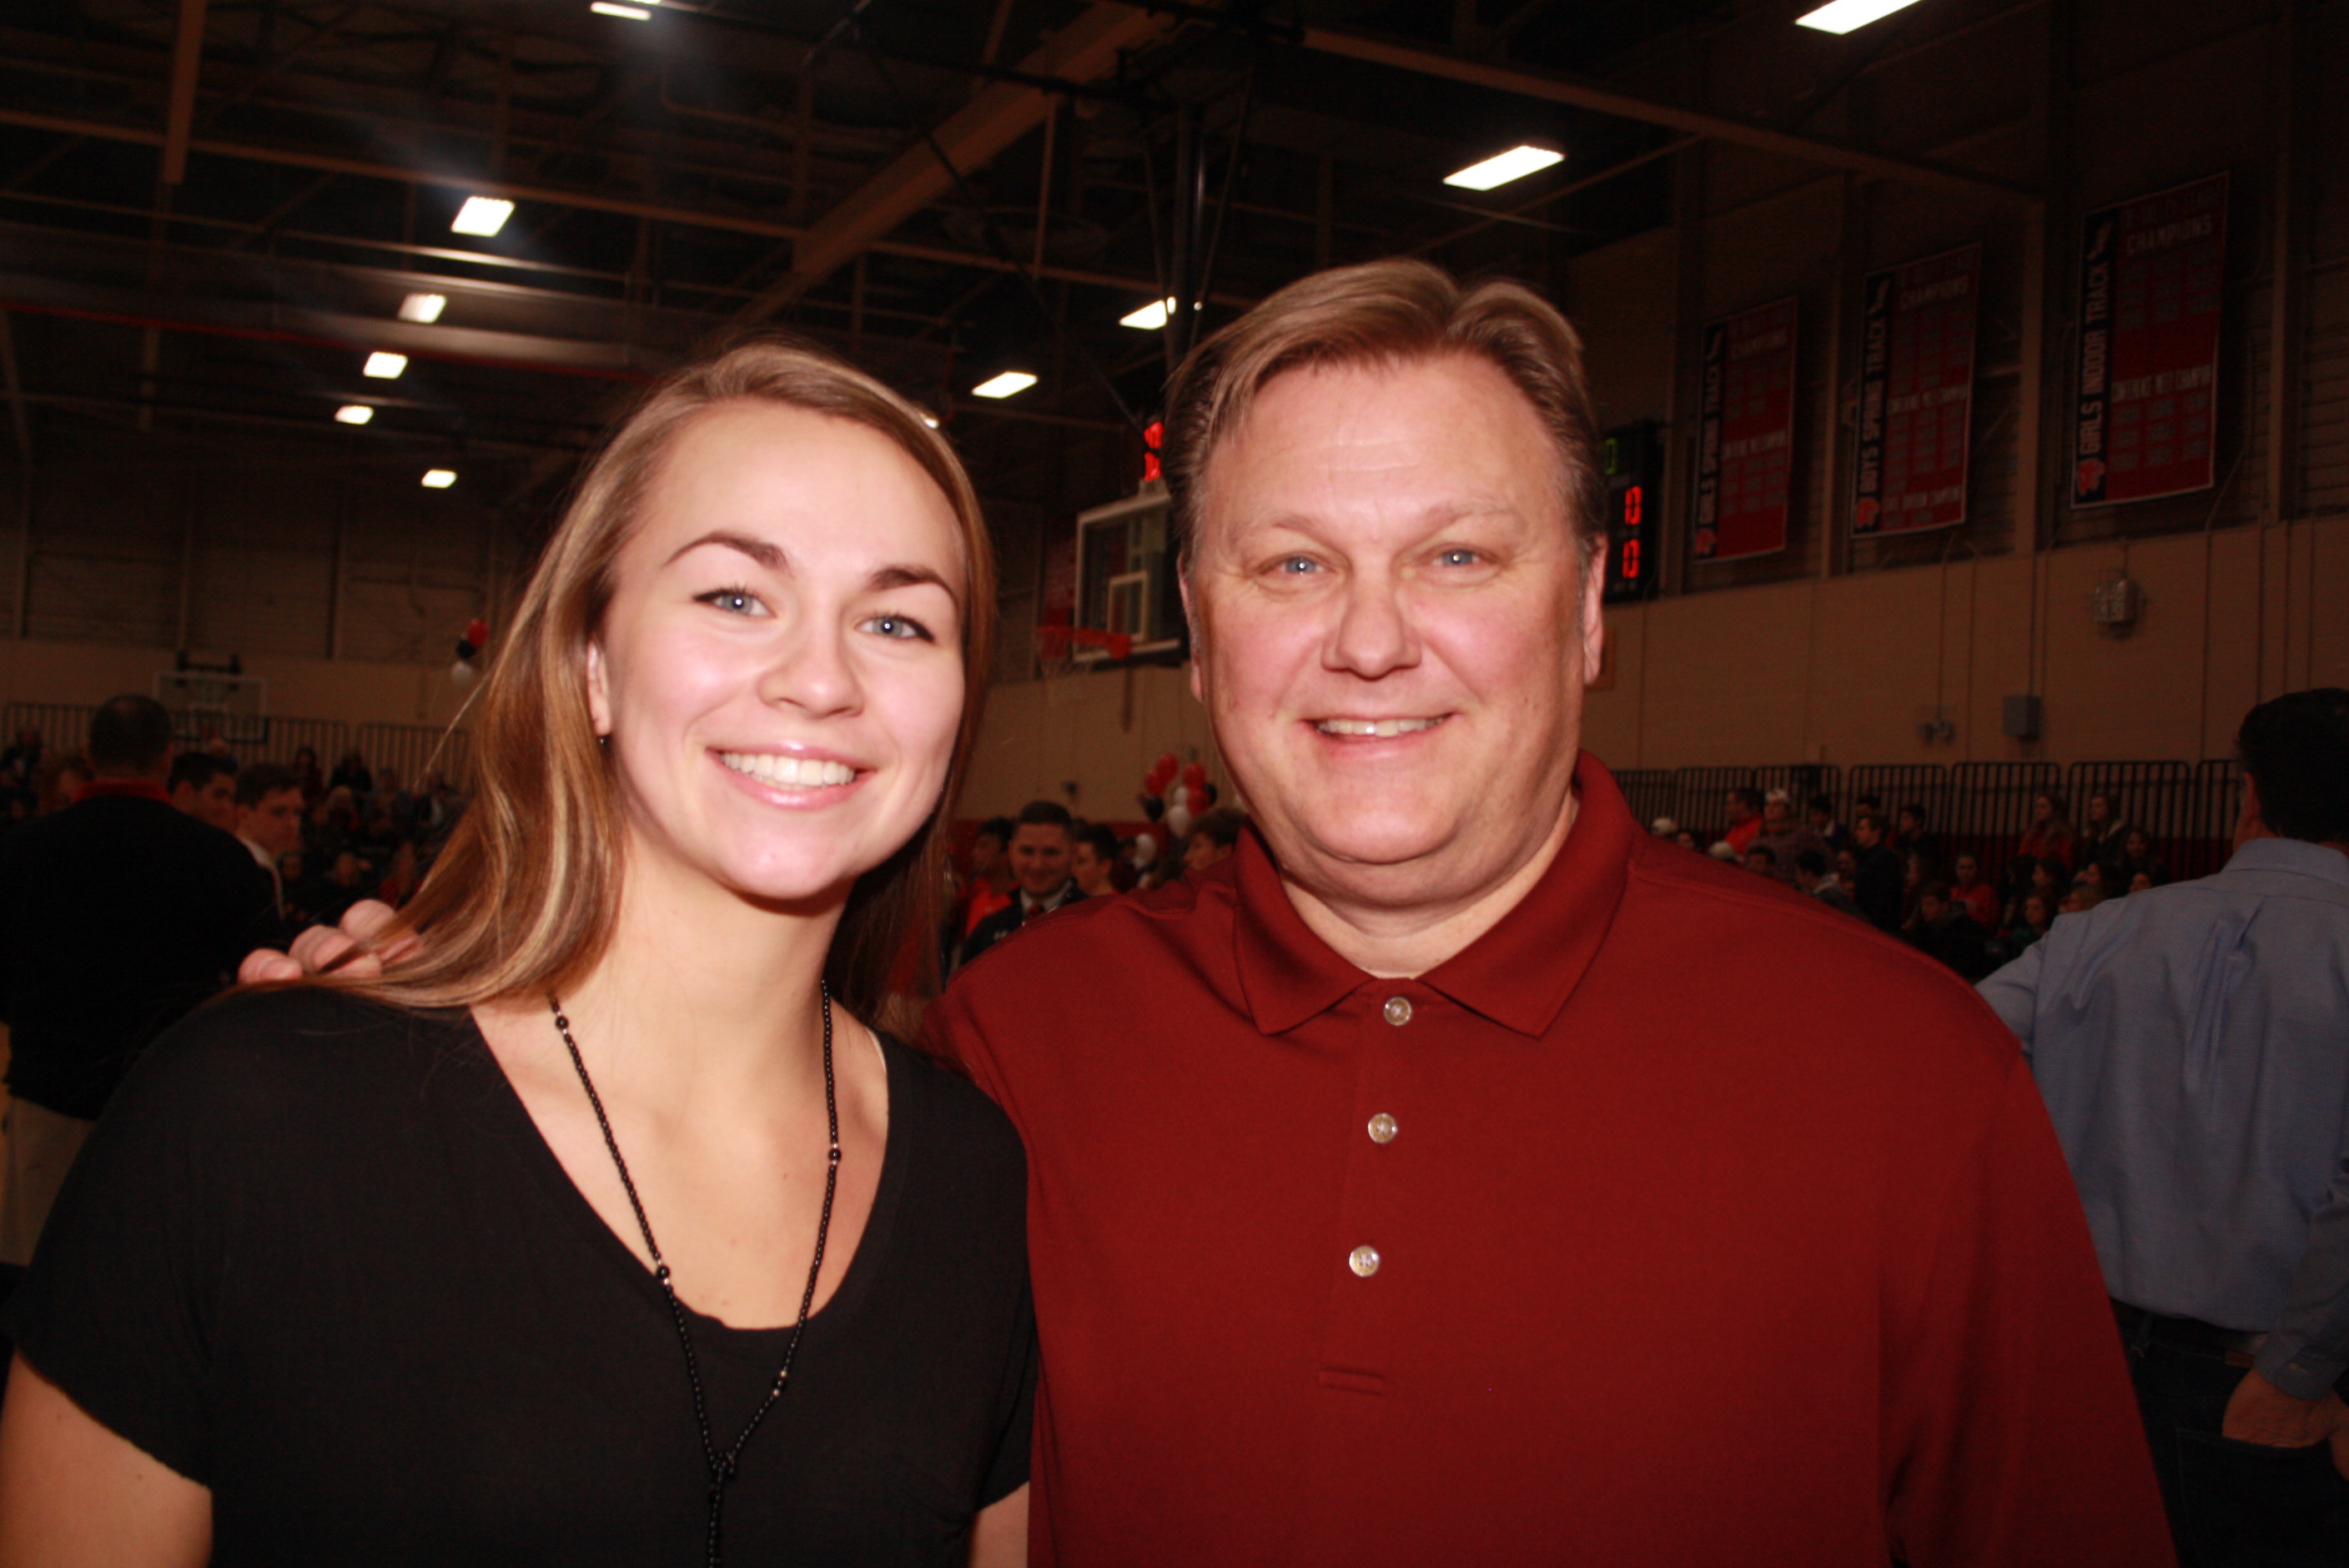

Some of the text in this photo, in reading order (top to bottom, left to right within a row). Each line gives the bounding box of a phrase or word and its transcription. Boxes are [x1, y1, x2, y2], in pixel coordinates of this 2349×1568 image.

[2126, 214, 2212, 254] CHAMPIONS
[1899, 274, 1968, 310] CHAMPIONS
[1859, 317, 1887, 493] BOYS SPRING TRACK
[2079, 261, 2110, 455] GIRLS INDOOR TRACK
